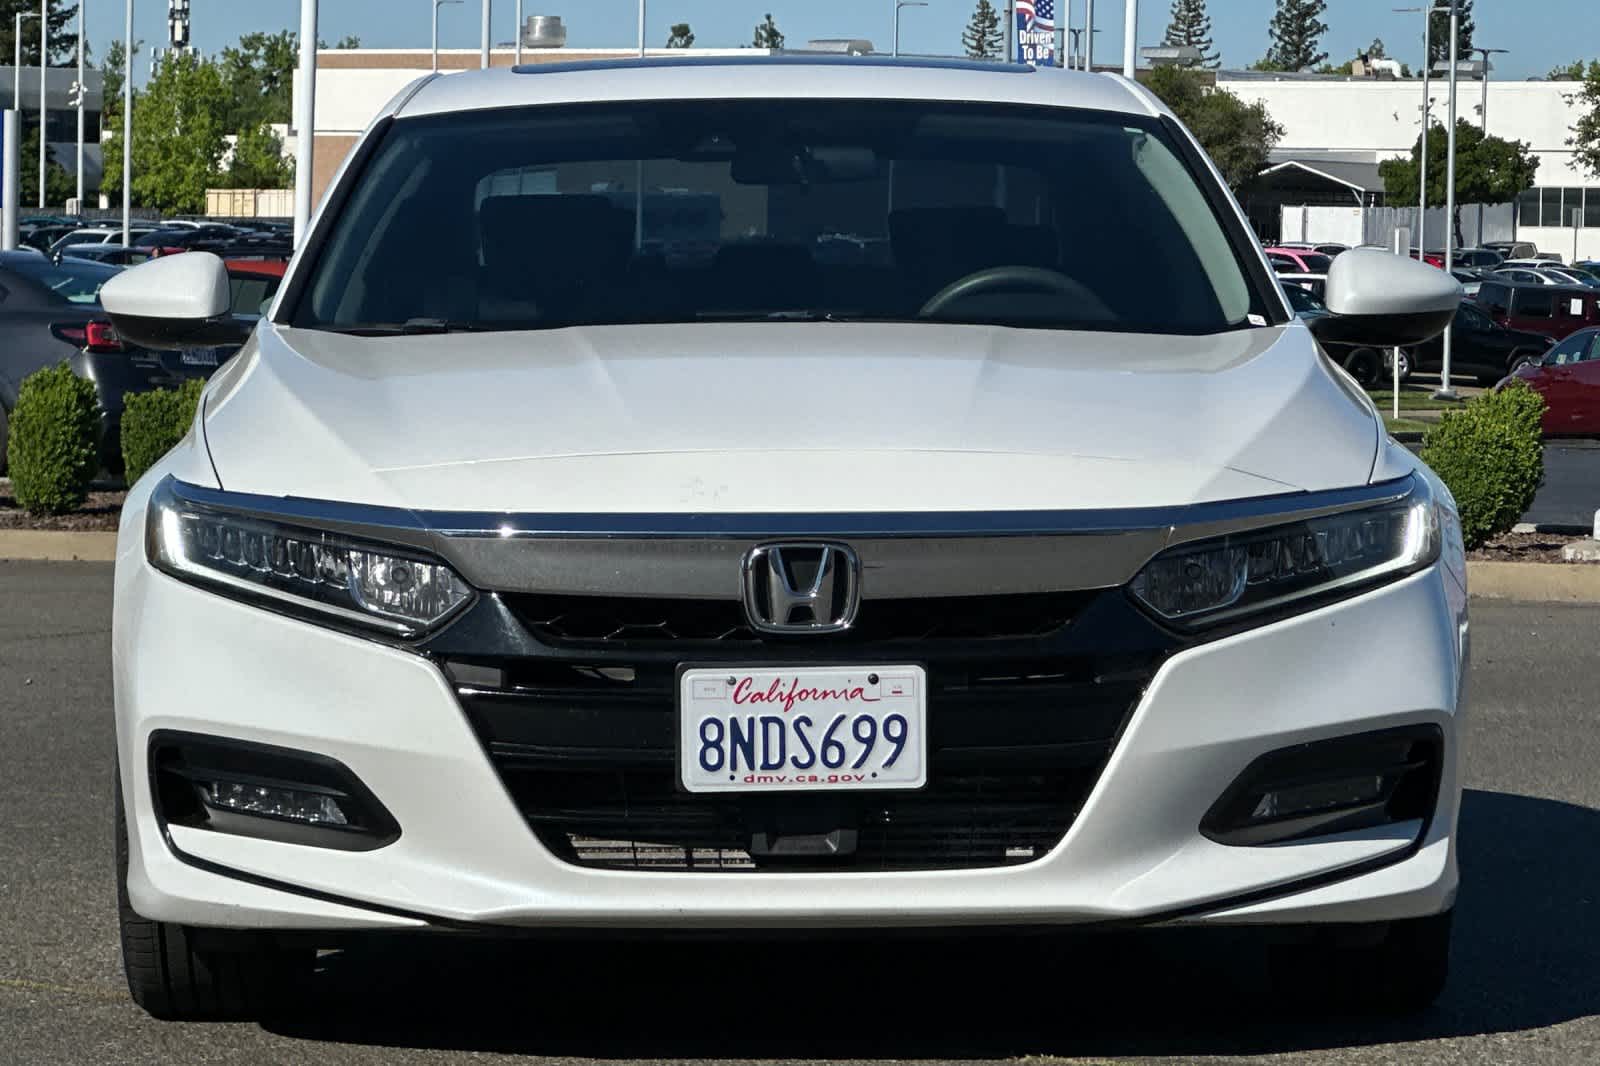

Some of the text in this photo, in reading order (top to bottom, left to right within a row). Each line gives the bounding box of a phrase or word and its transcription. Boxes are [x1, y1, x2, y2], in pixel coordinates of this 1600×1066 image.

[1020, 30, 1051, 44] Driven
[1022, 45, 1049, 60] To Be
[733, 676, 881, 712] California
[699, 713, 908, 772] 8NDS699
[743, 774, 865, 783] dmv.ca.gov
